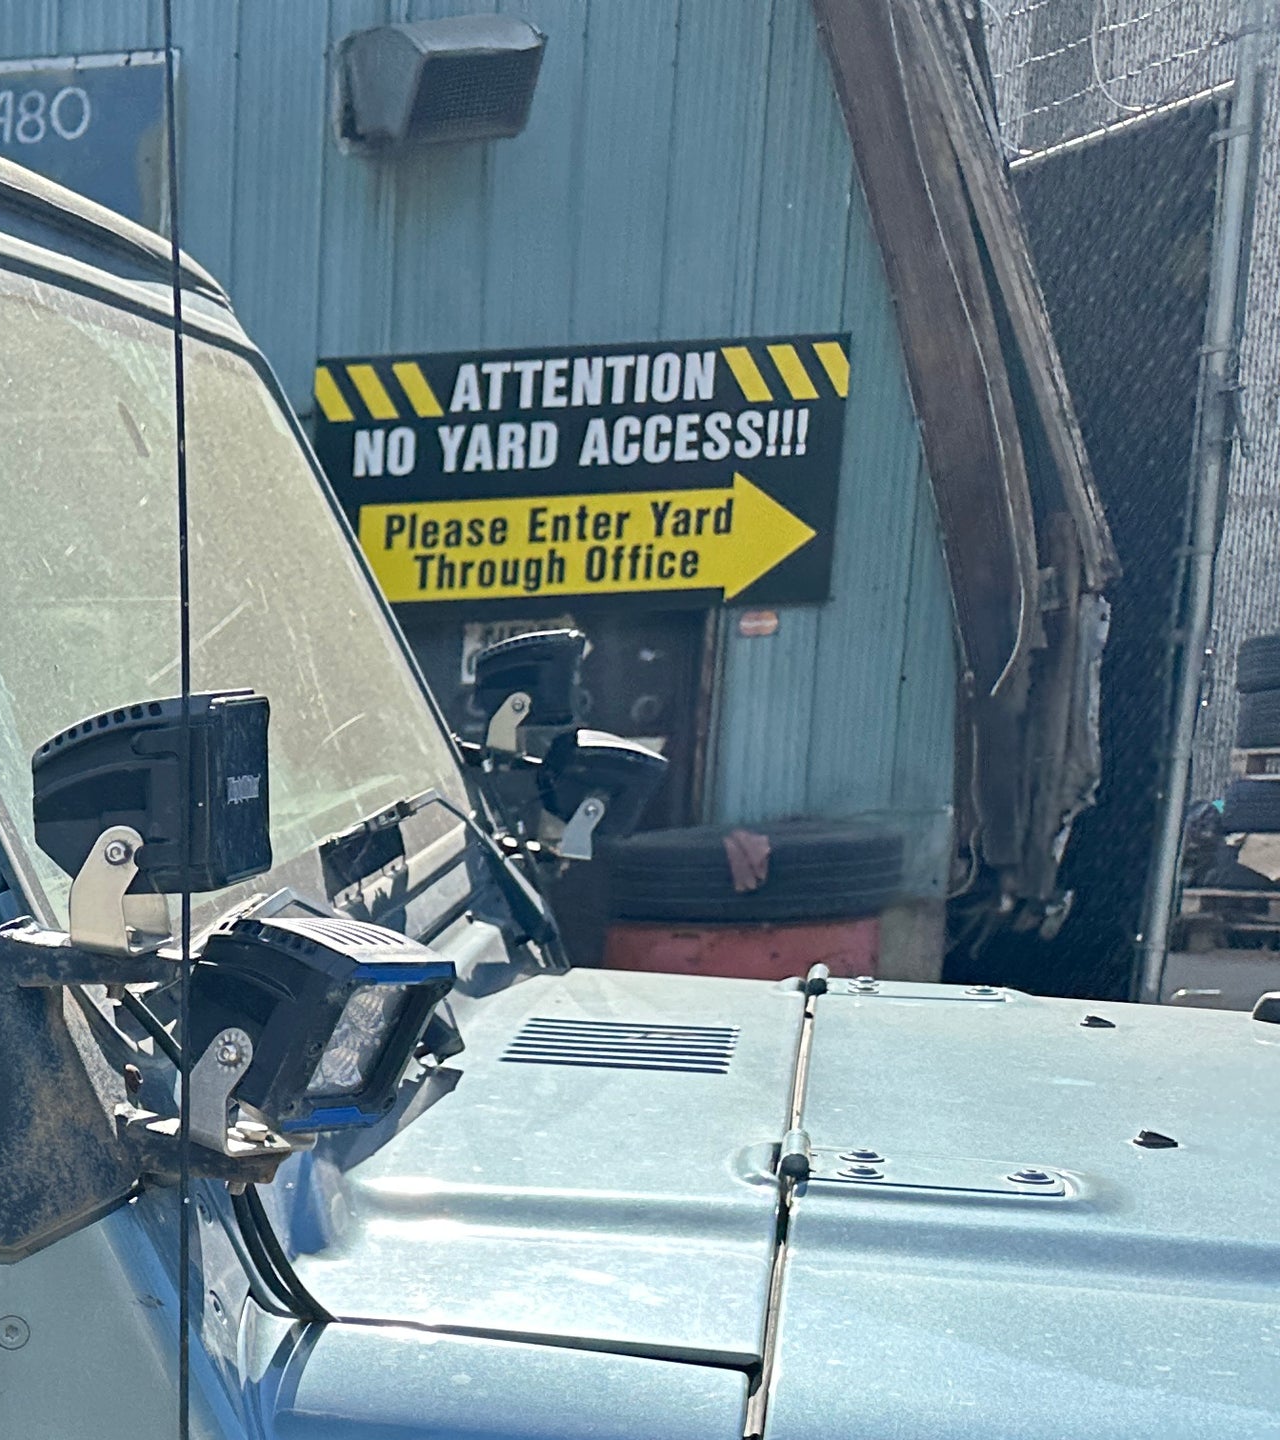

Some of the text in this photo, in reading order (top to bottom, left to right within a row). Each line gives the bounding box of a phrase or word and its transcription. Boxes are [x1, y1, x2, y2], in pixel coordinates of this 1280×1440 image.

[450, 351, 716, 413] ATTENTION
[353, 409, 809, 478] NO YARD ACCESS!!!
[384, 499, 734, 550] Please Enter Yard
[414, 544, 699, 592] Through Office
